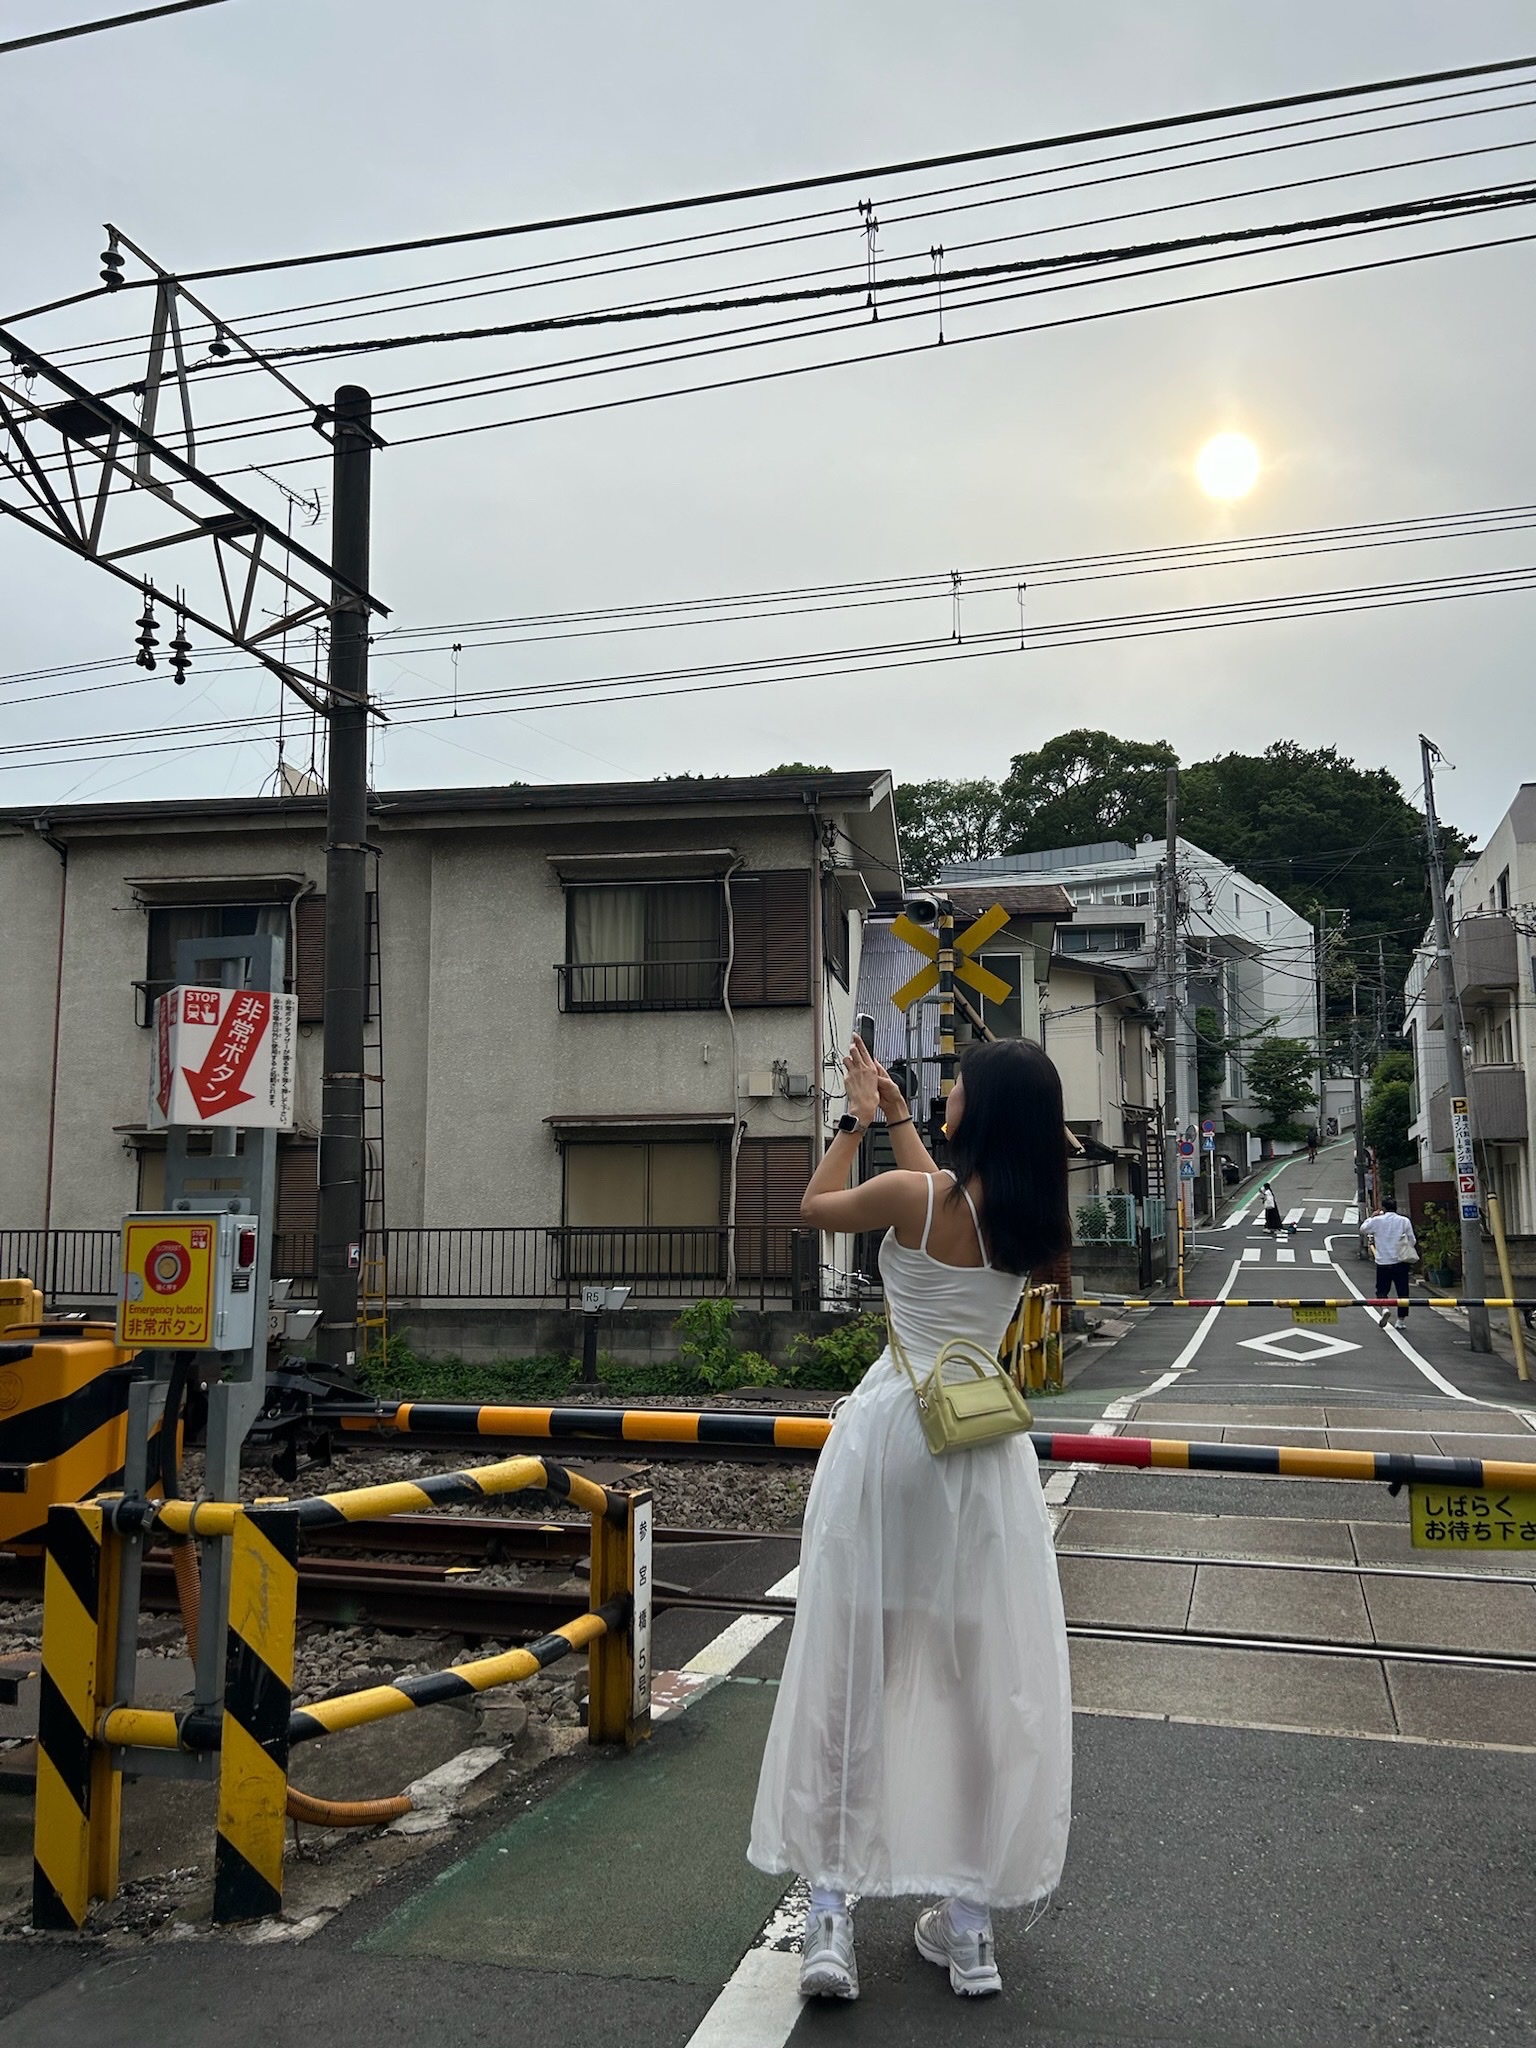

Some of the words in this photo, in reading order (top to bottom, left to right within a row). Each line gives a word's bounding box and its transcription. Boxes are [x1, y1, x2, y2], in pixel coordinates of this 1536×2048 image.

[186, 991, 218, 1003] STOP
[200, 997, 265, 1102] 非常ボタン
[1453, 1100, 1466, 1114] P
[1454, 1115, 1465, 1162] コインパーキング
[586, 1291, 599, 1302] R5
[128, 1304, 175, 1316] Emergency
[176, 1304, 204, 1315] button
[128, 1318, 202, 1336] 非常ボタン
[1425, 1494, 1513, 1518] しばらく
[1425, 1520, 1536, 1542] お待ち下さ
